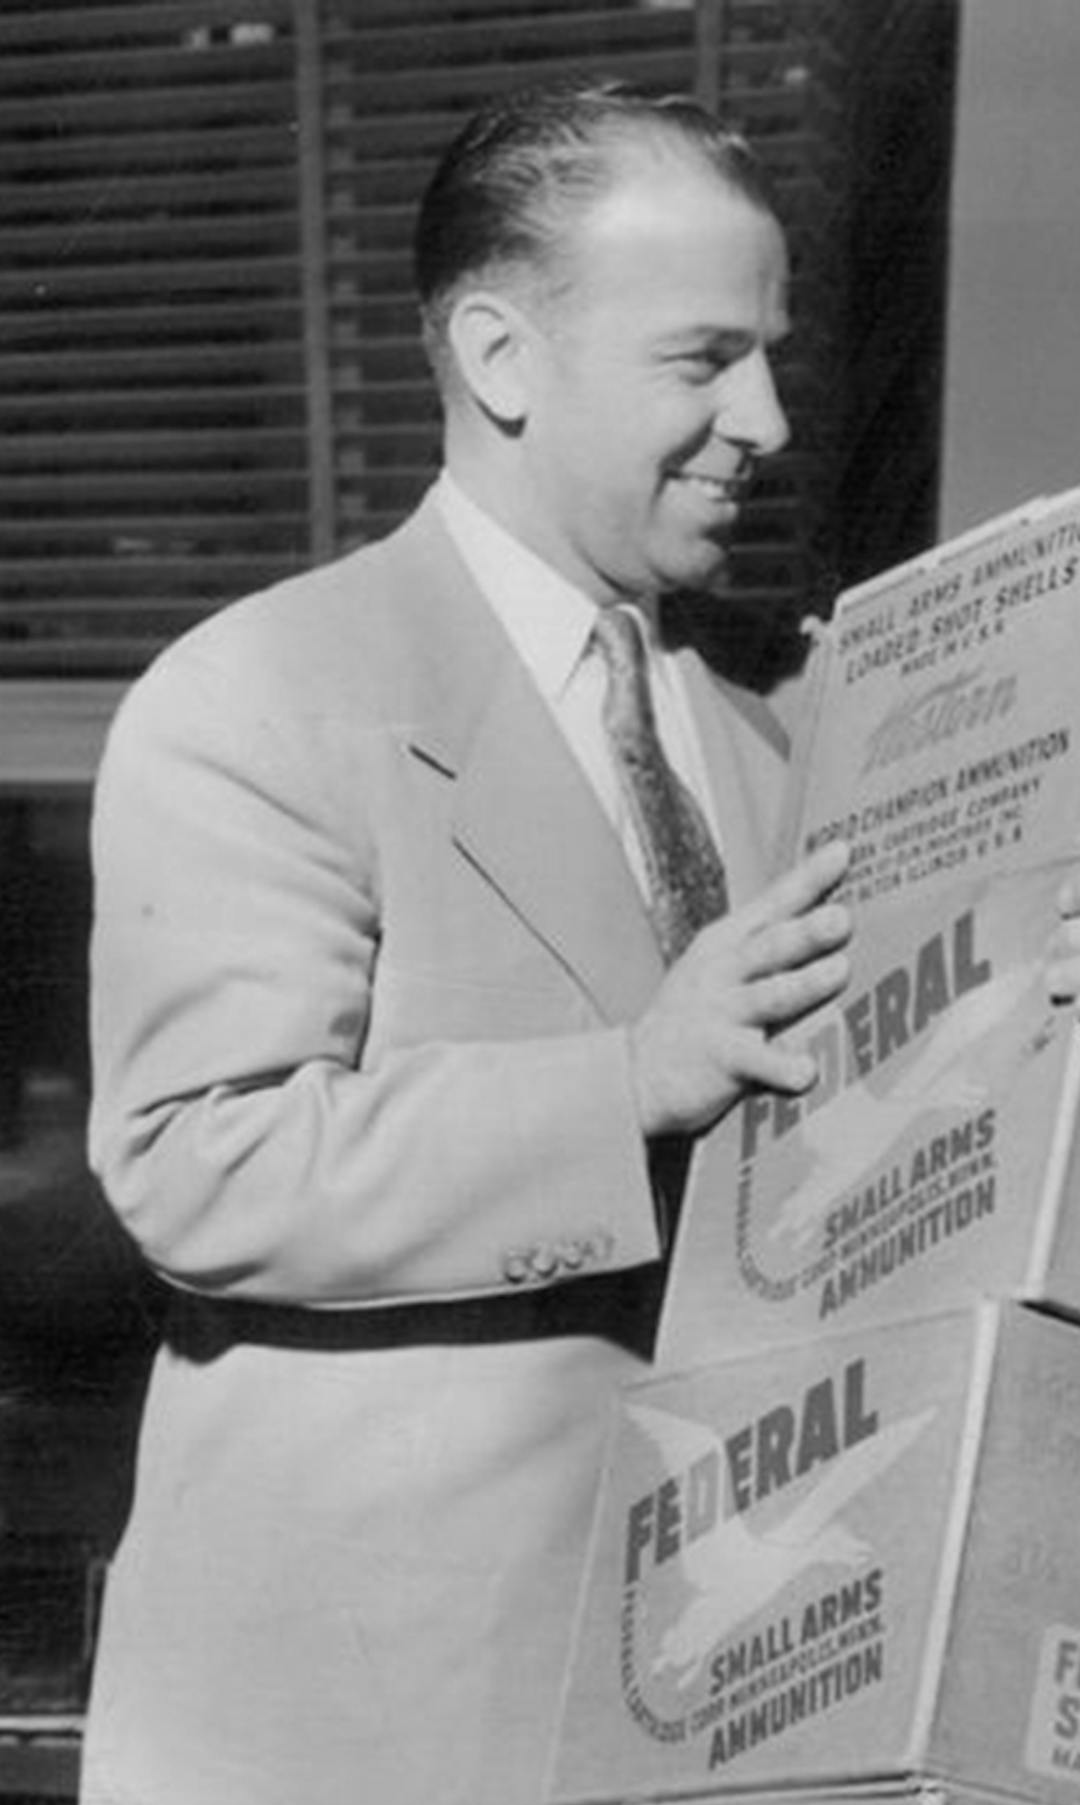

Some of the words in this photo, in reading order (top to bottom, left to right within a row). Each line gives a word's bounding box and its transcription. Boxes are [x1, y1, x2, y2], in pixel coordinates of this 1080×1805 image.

[931, 596, 984, 641] SHOT
[995, 556, 1079, 615] SHELLS
[818, 1174, 997, 1322] AMMUNITION
[822, 1166, 905, 1252] SMALL
[909, 1107, 997, 1185] ARMS
[624, 1357, 881, 1586] FEDERAL
[709, 1617, 796, 1699] SMALL
[799, 1567, 885, 1647] ARMS
[706, 1640, 886, 1772] AMMUNITION
